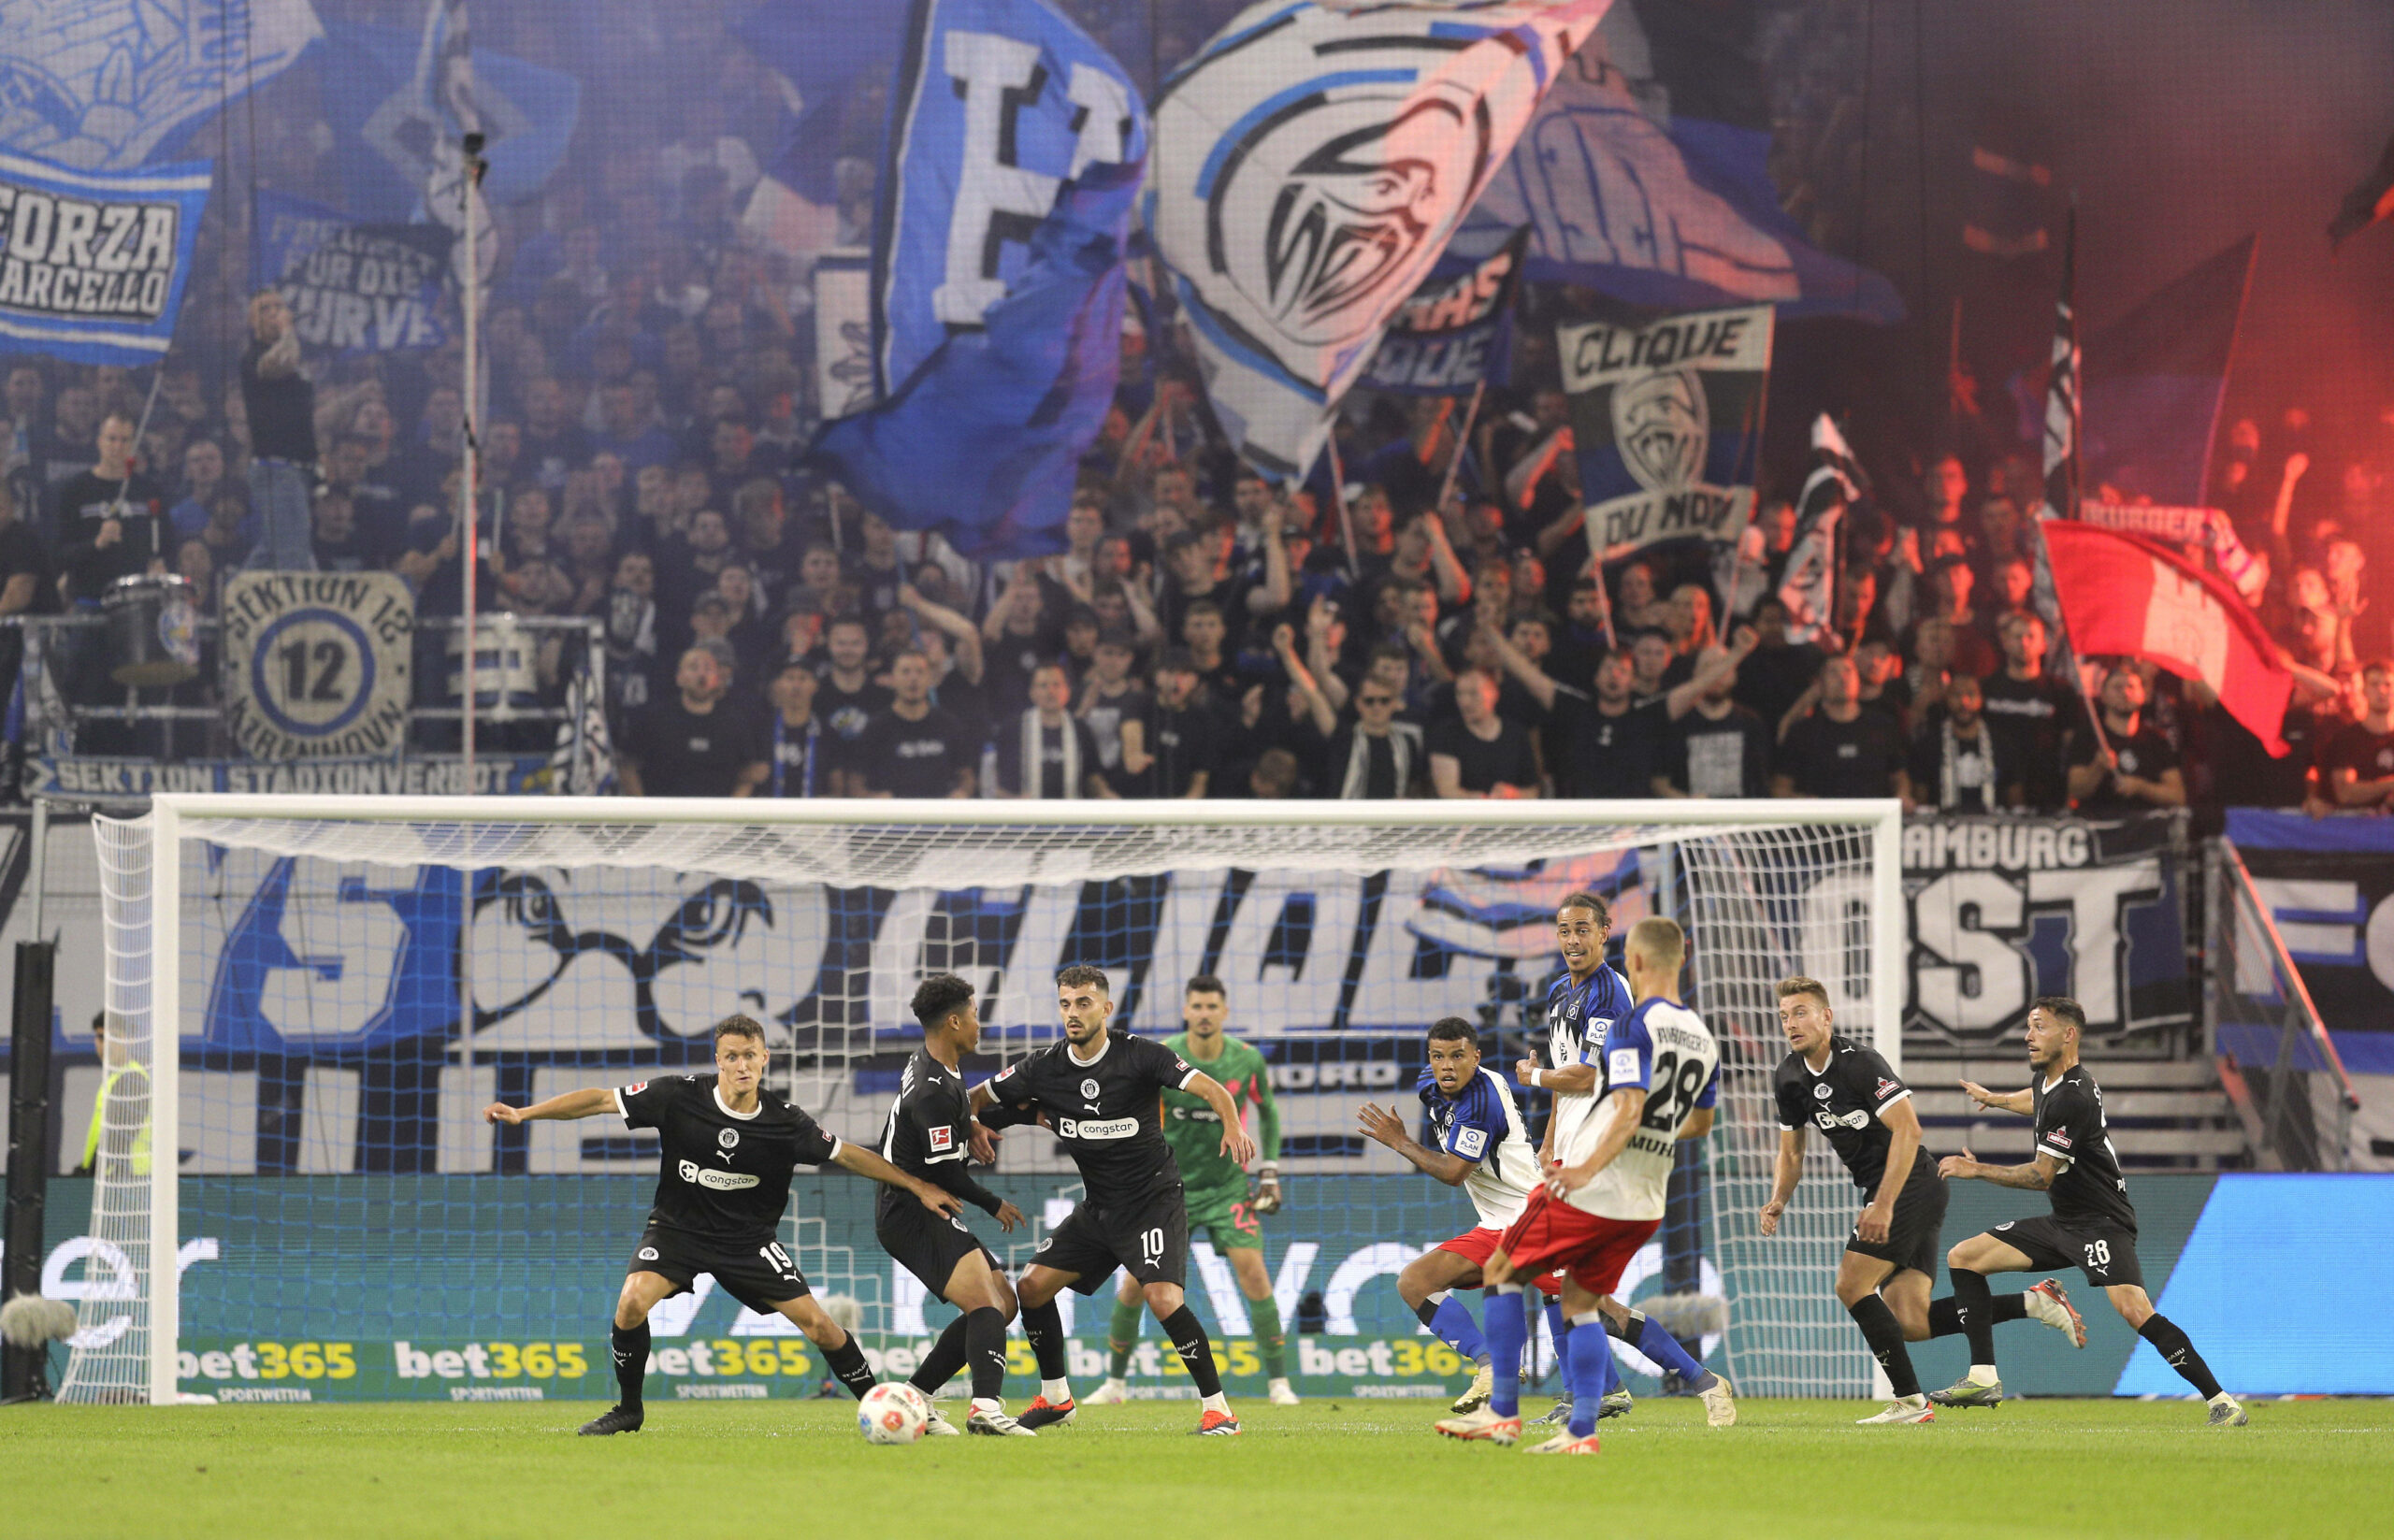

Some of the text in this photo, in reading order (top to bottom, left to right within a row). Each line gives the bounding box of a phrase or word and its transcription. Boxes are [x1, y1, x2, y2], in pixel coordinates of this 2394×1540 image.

[0, 258, 168, 312] ARCELLO
[1575, 318, 1751, 377] CLIQUE
[1605, 502, 1651, 546] DU
[280, 640, 345, 700] 12
[58, 760, 514, 795] SEKTION STADIONVERBOT
[1902, 823, 2091, 867] AMBURG
[1641, 1051, 1705, 1132] 28
[1083, 1122, 1133, 1136] congstar
[1460, 1140, 1479, 1151] PLAN
[704, 1173, 755, 1187] congstar
[759, 1242, 793, 1274] 19
[1141, 1228, 1164, 1259] 10
[2084, 1239, 2112, 1267] 28
[394, 1341, 589, 1379] bet365
[218, 1388, 312, 1402] SPORTWETTEN
[451, 1386, 544, 1401] SPORTWETTEN
[675, 1384, 768, 1398] SPORTWETTEN
